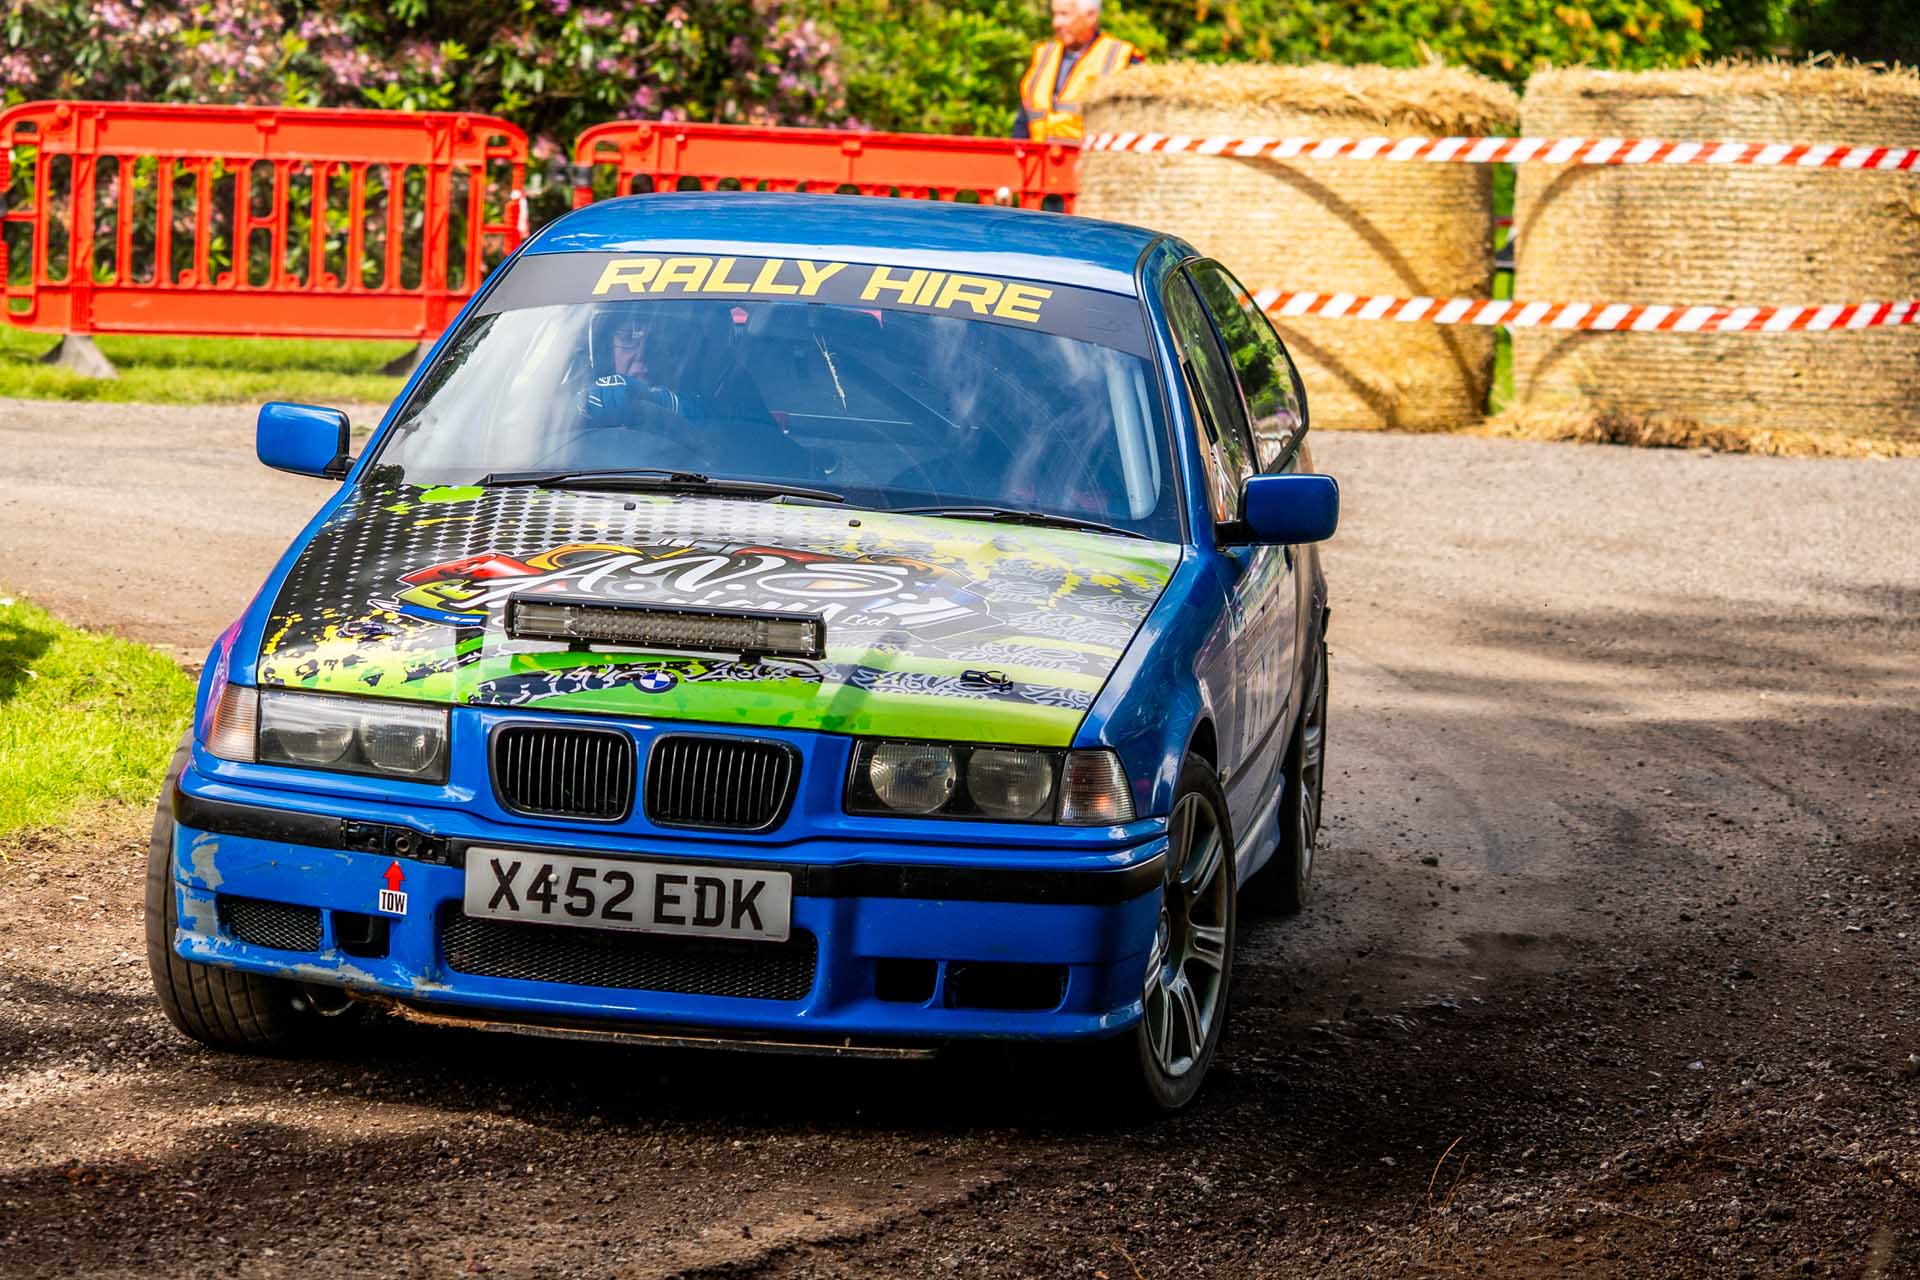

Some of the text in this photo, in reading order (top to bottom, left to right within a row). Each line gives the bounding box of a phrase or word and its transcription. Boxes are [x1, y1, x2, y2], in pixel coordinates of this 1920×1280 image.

[592, 257, 1053, 323] RALLY HIRE
[840, 614, 890, 627] Ltd
[381, 891, 405, 912] TOW
[488, 858, 766, 931] X452 EDK
